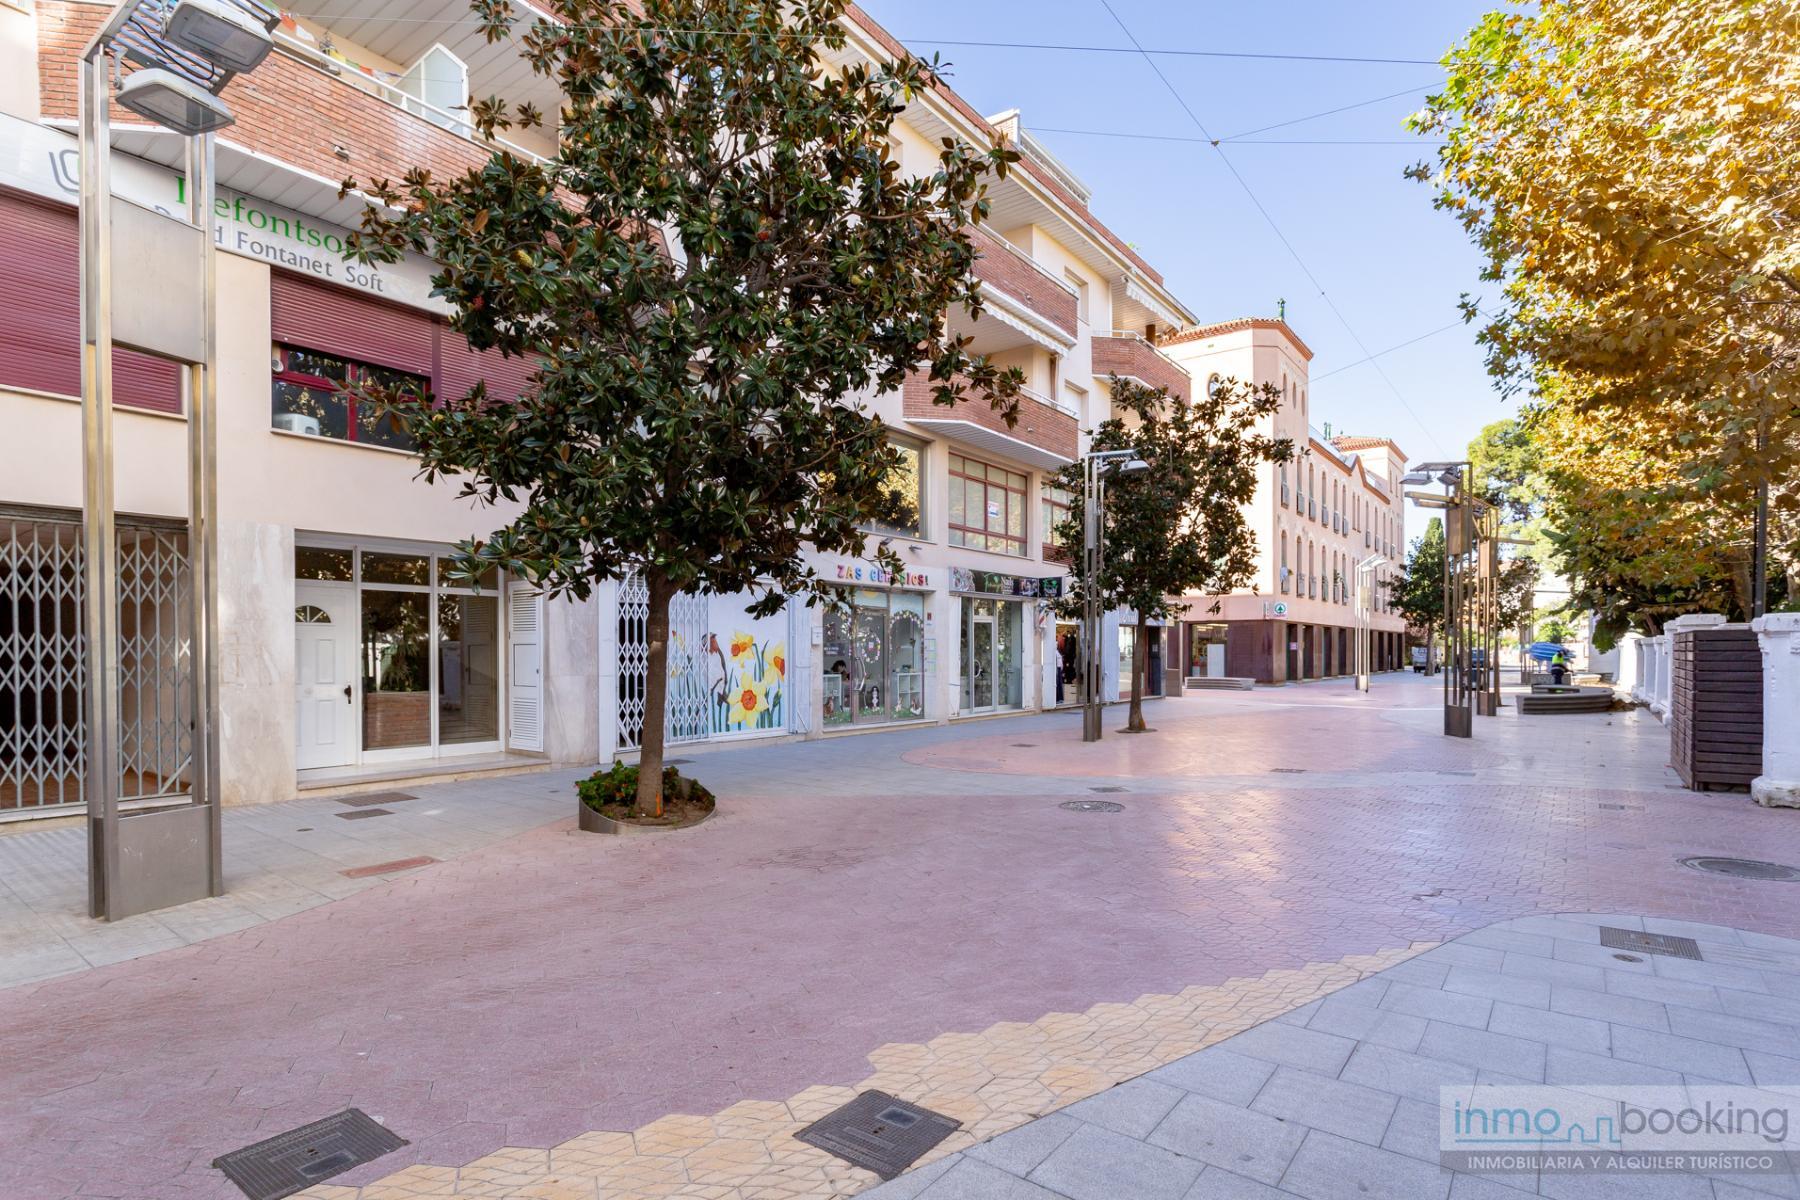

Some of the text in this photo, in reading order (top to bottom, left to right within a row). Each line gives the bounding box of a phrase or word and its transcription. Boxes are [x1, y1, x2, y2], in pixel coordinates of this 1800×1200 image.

[237, 231, 384, 292] Fontanet Soft
[837, 565, 862, 581] ZAS
